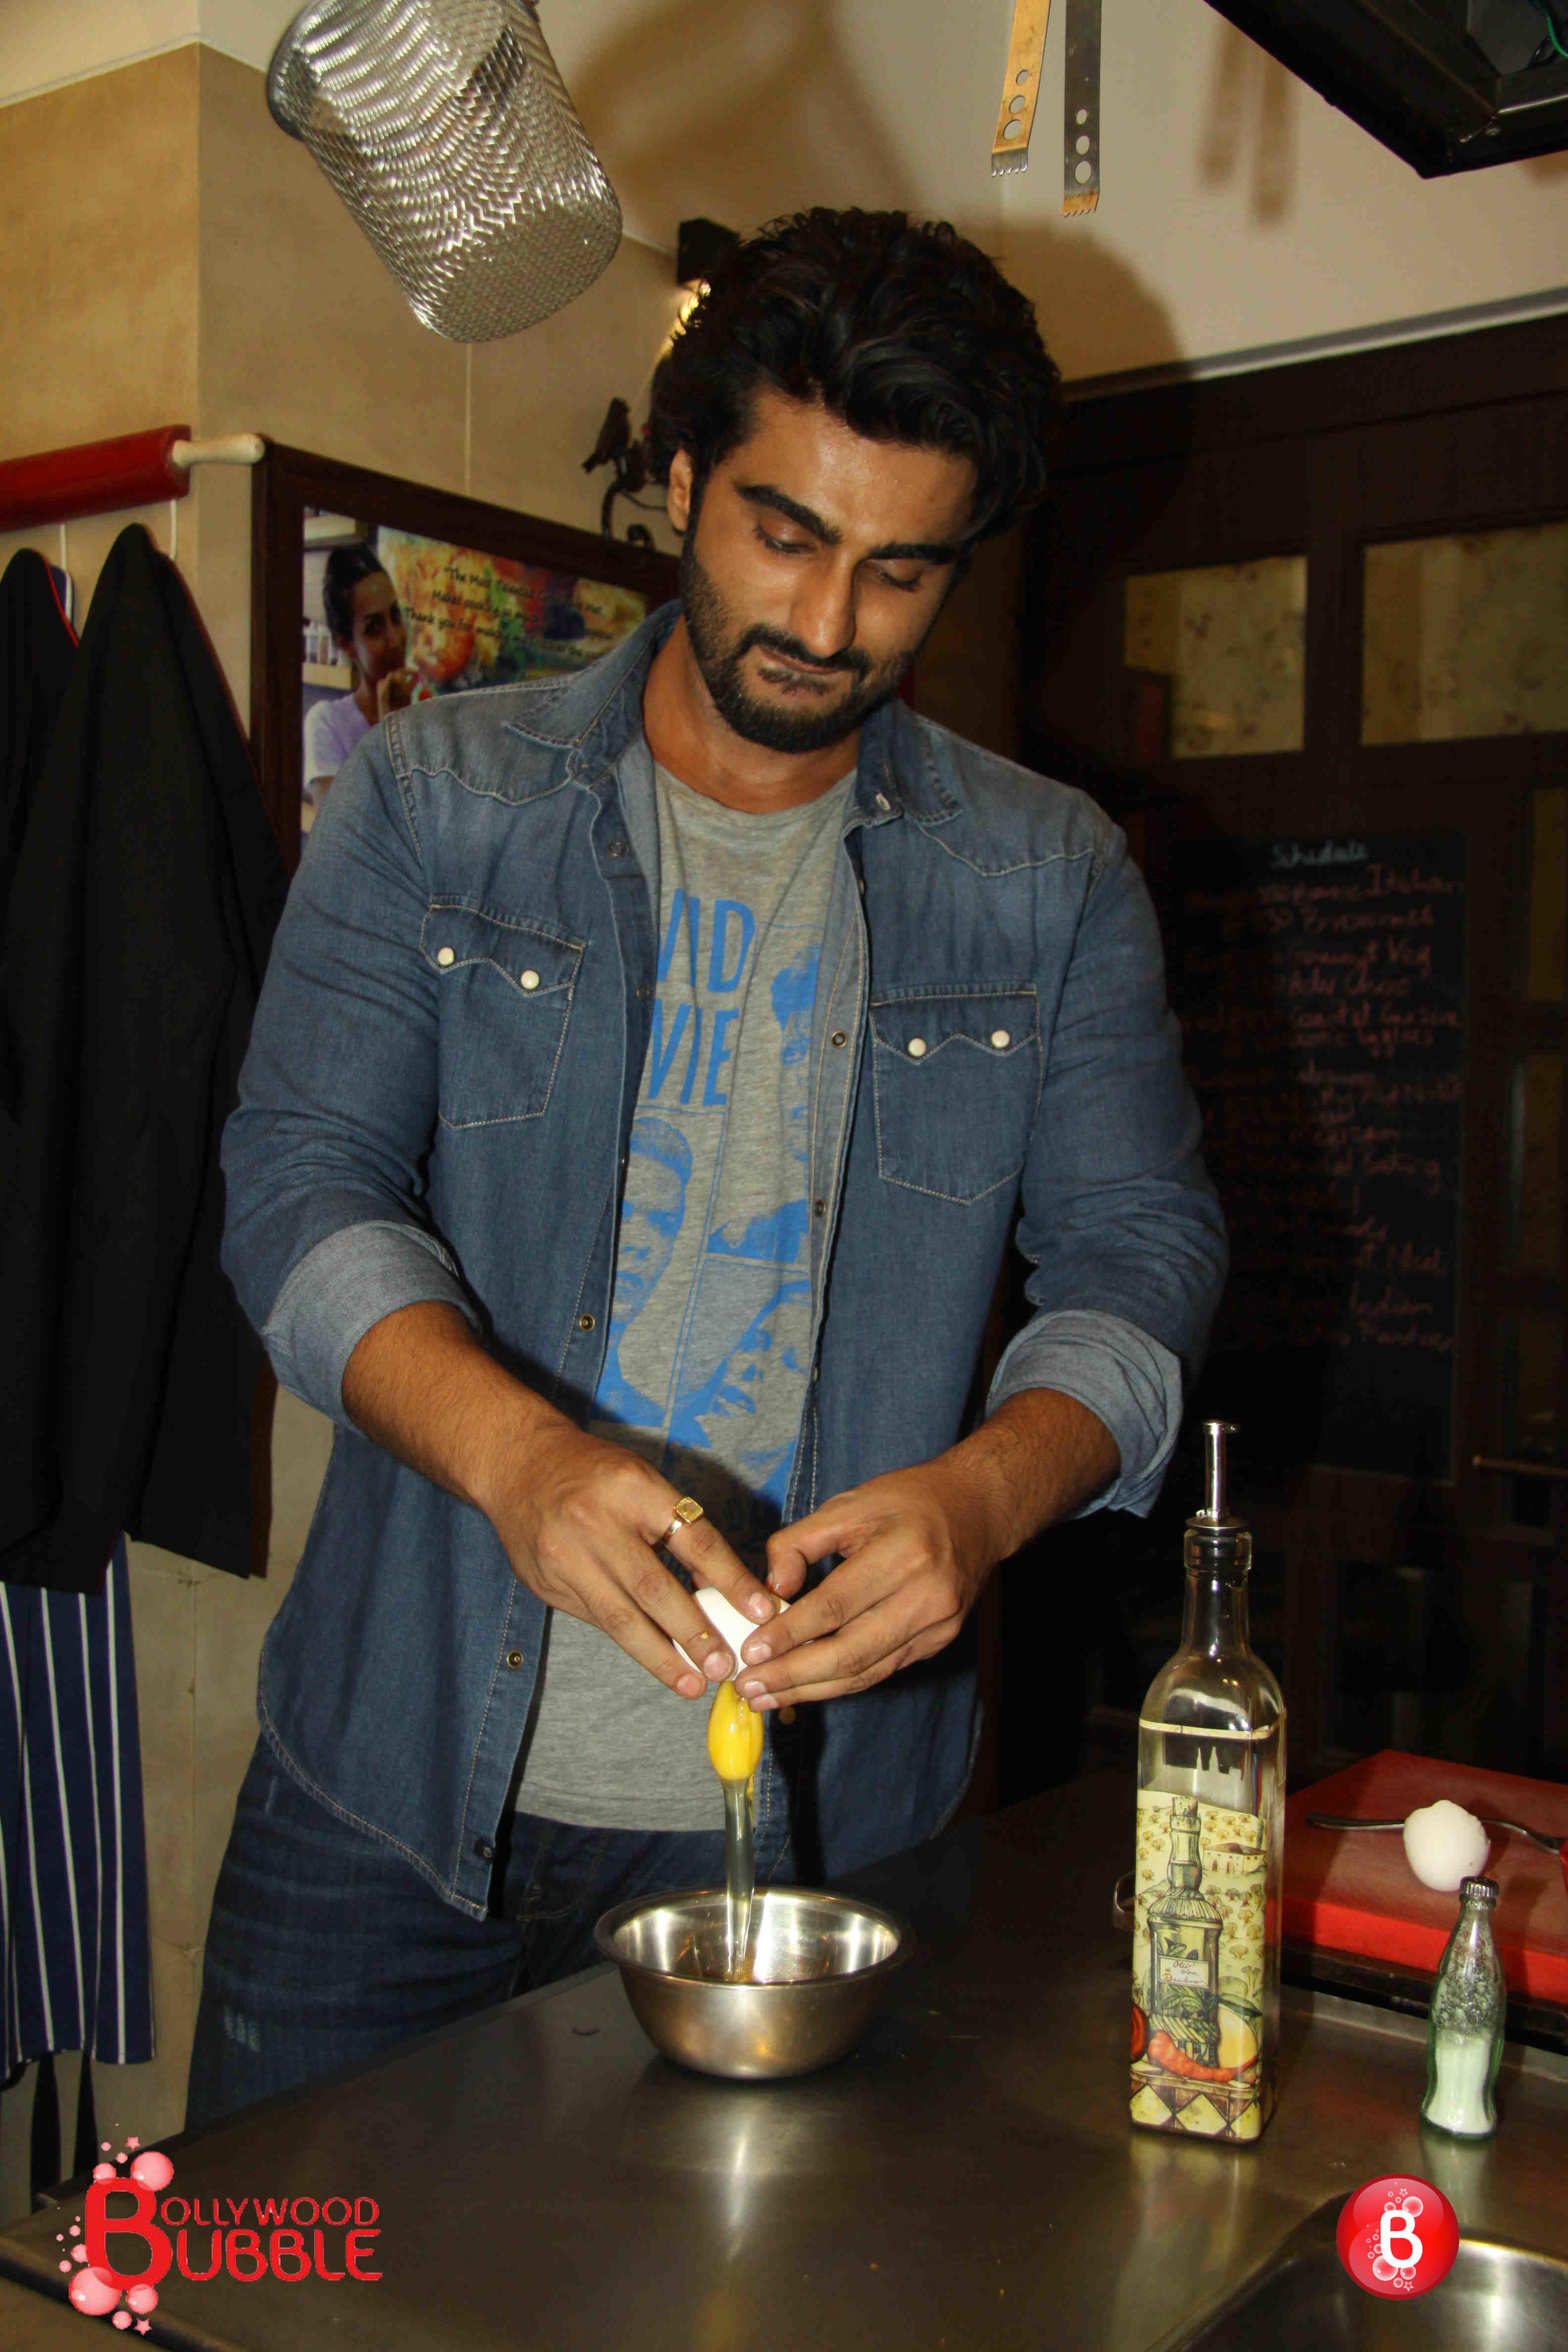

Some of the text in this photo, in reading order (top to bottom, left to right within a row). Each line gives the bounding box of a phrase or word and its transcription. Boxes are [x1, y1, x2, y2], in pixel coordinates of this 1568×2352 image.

[405, 607, 434, 624] Thank
[438, 617, 456, 630] you
[457, 617, 473, 632] for
